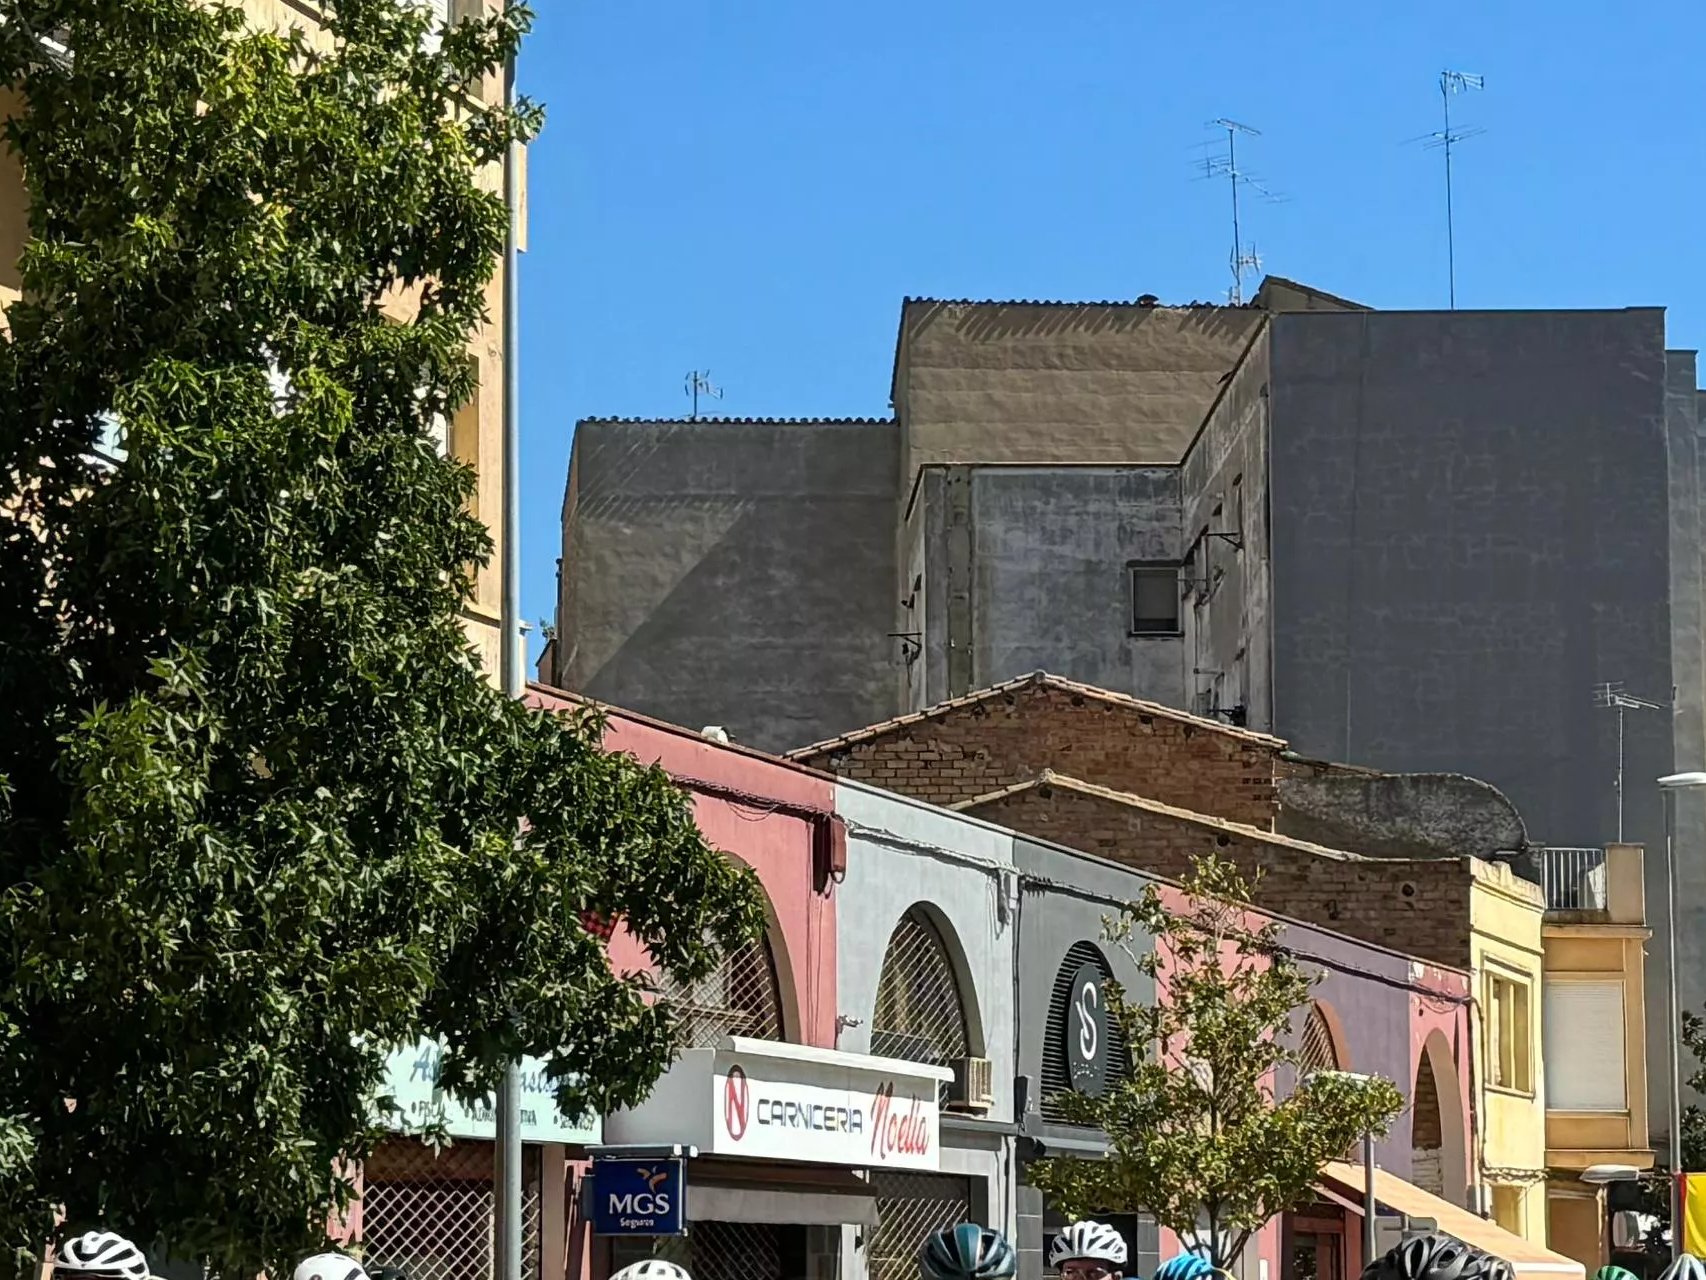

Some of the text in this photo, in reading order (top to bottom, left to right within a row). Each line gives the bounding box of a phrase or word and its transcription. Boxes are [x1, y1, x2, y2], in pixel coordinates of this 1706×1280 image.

[757, 1081, 930, 1160] CARNICERIA Noelia
[609, 1193, 671, 1215] MGS
